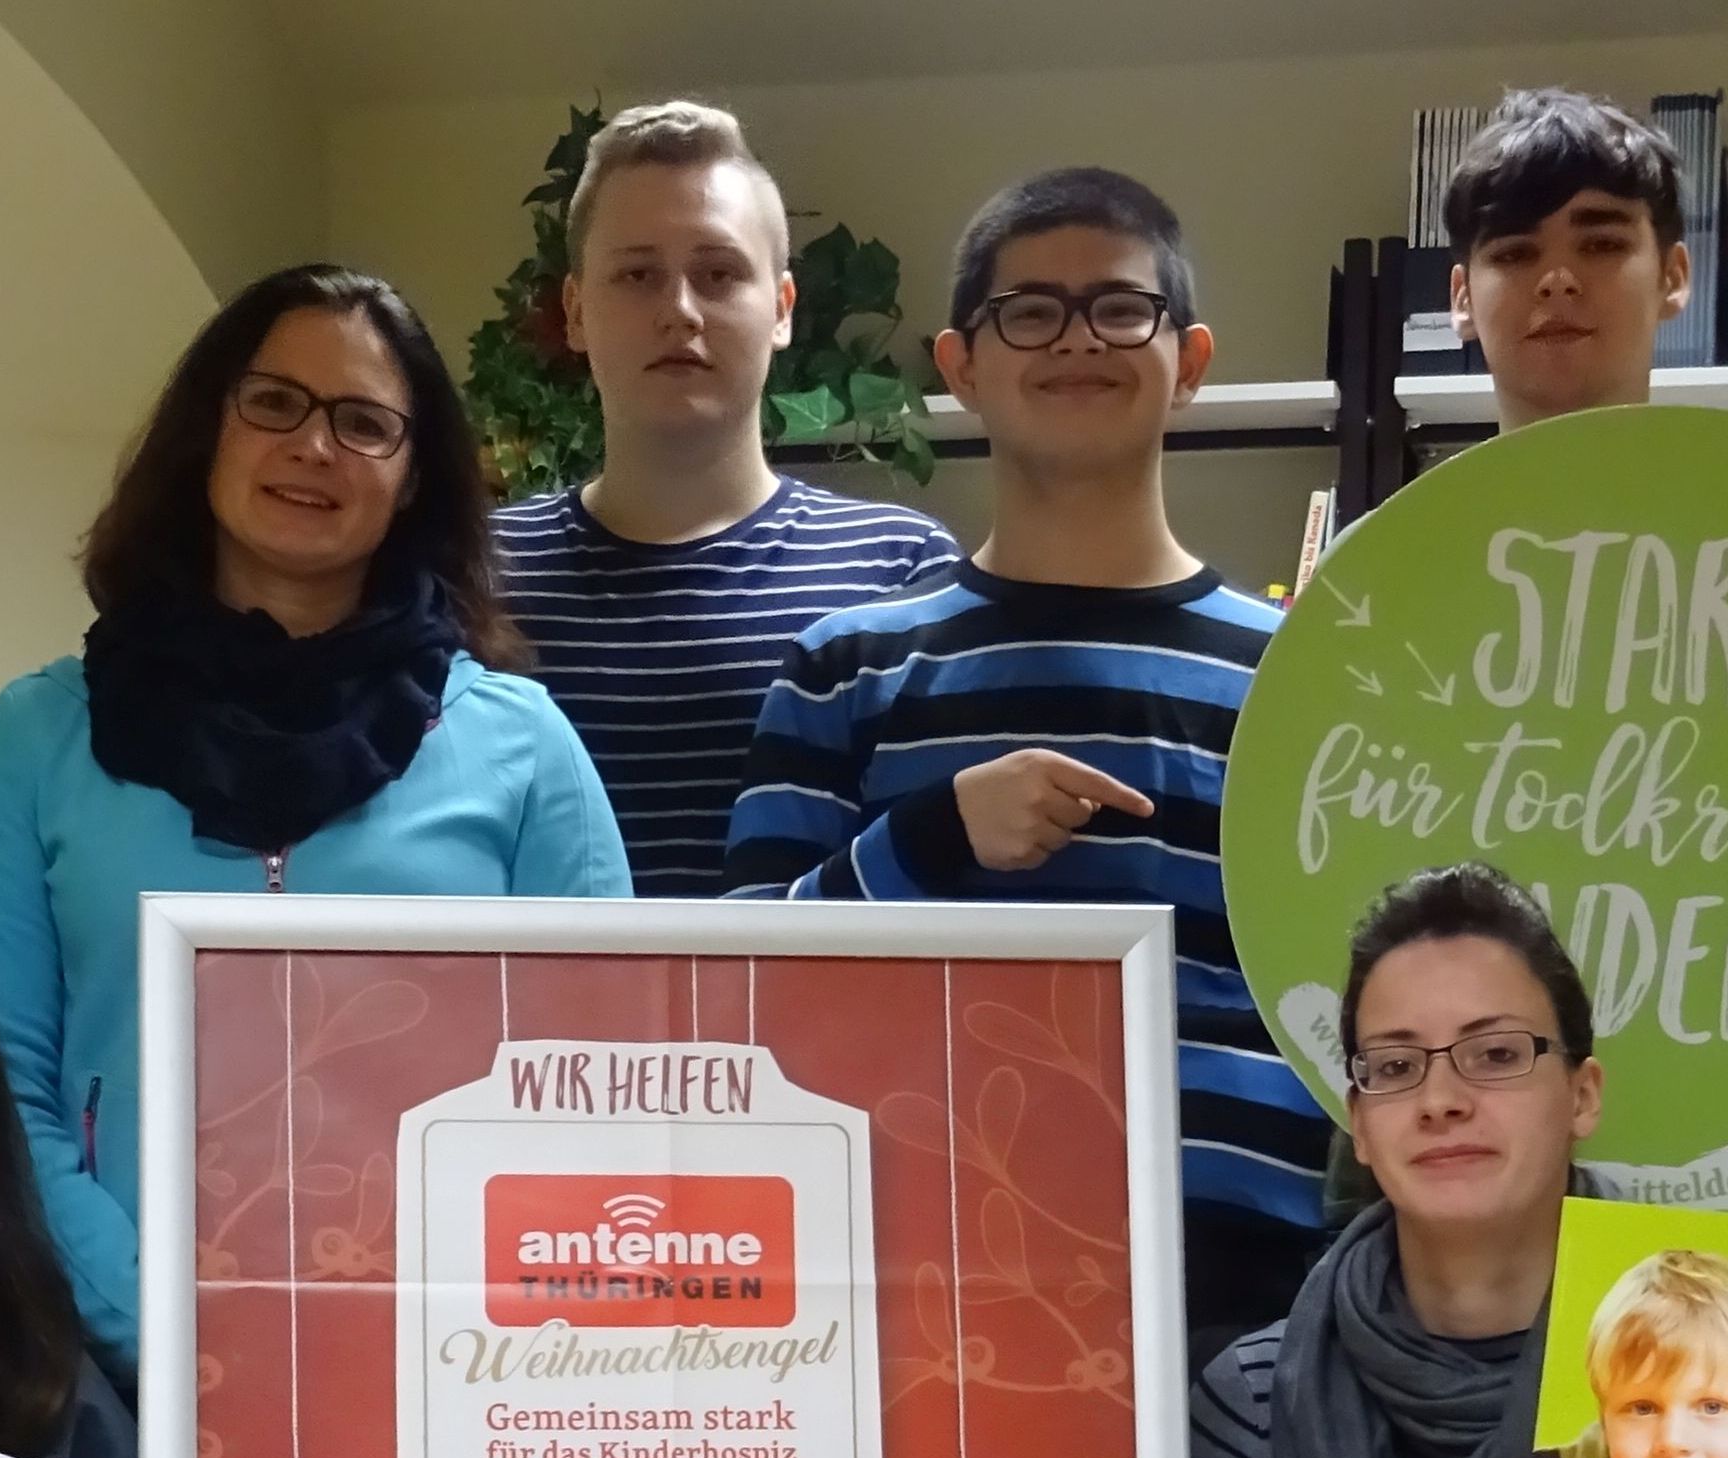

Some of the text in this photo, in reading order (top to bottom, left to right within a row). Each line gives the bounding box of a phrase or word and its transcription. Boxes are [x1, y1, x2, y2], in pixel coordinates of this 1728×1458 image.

[1307, 505, 1322, 545] Kanada
[1295, 722, 1464, 874] für
[510, 1053, 754, 1115] WIR HELFEN
[518, 1223, 763, 1265] antenne
[518, 1271, 762, 1300] THÜRINGEN
[439, 1318, 840, 1384] Weihnachtsengel
[486, 1401, 796, 1431] Gemeinsam stark
